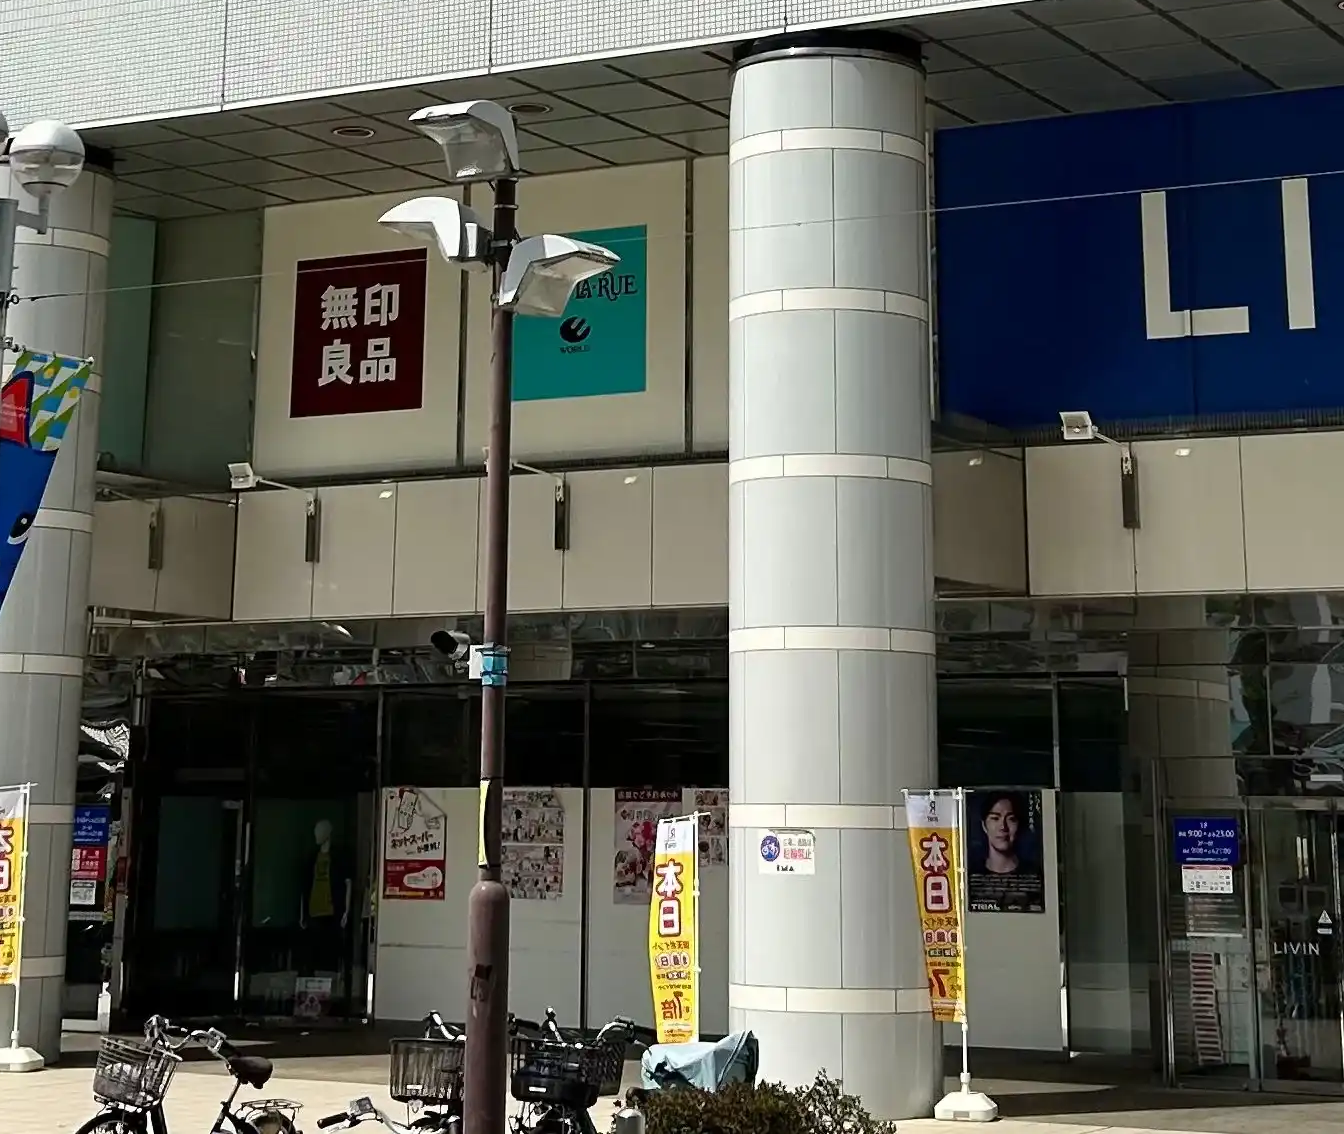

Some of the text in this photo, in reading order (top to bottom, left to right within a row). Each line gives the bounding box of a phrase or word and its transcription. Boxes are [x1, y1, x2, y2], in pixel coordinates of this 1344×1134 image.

[320, 282, 400, 329] 無印
[317, 336, 397, 387] 良品
[656, 858, 684, 937] 本日
[919, 832, 953, 913] 本日
[1273, 942, 1320, 956] LIVIN
